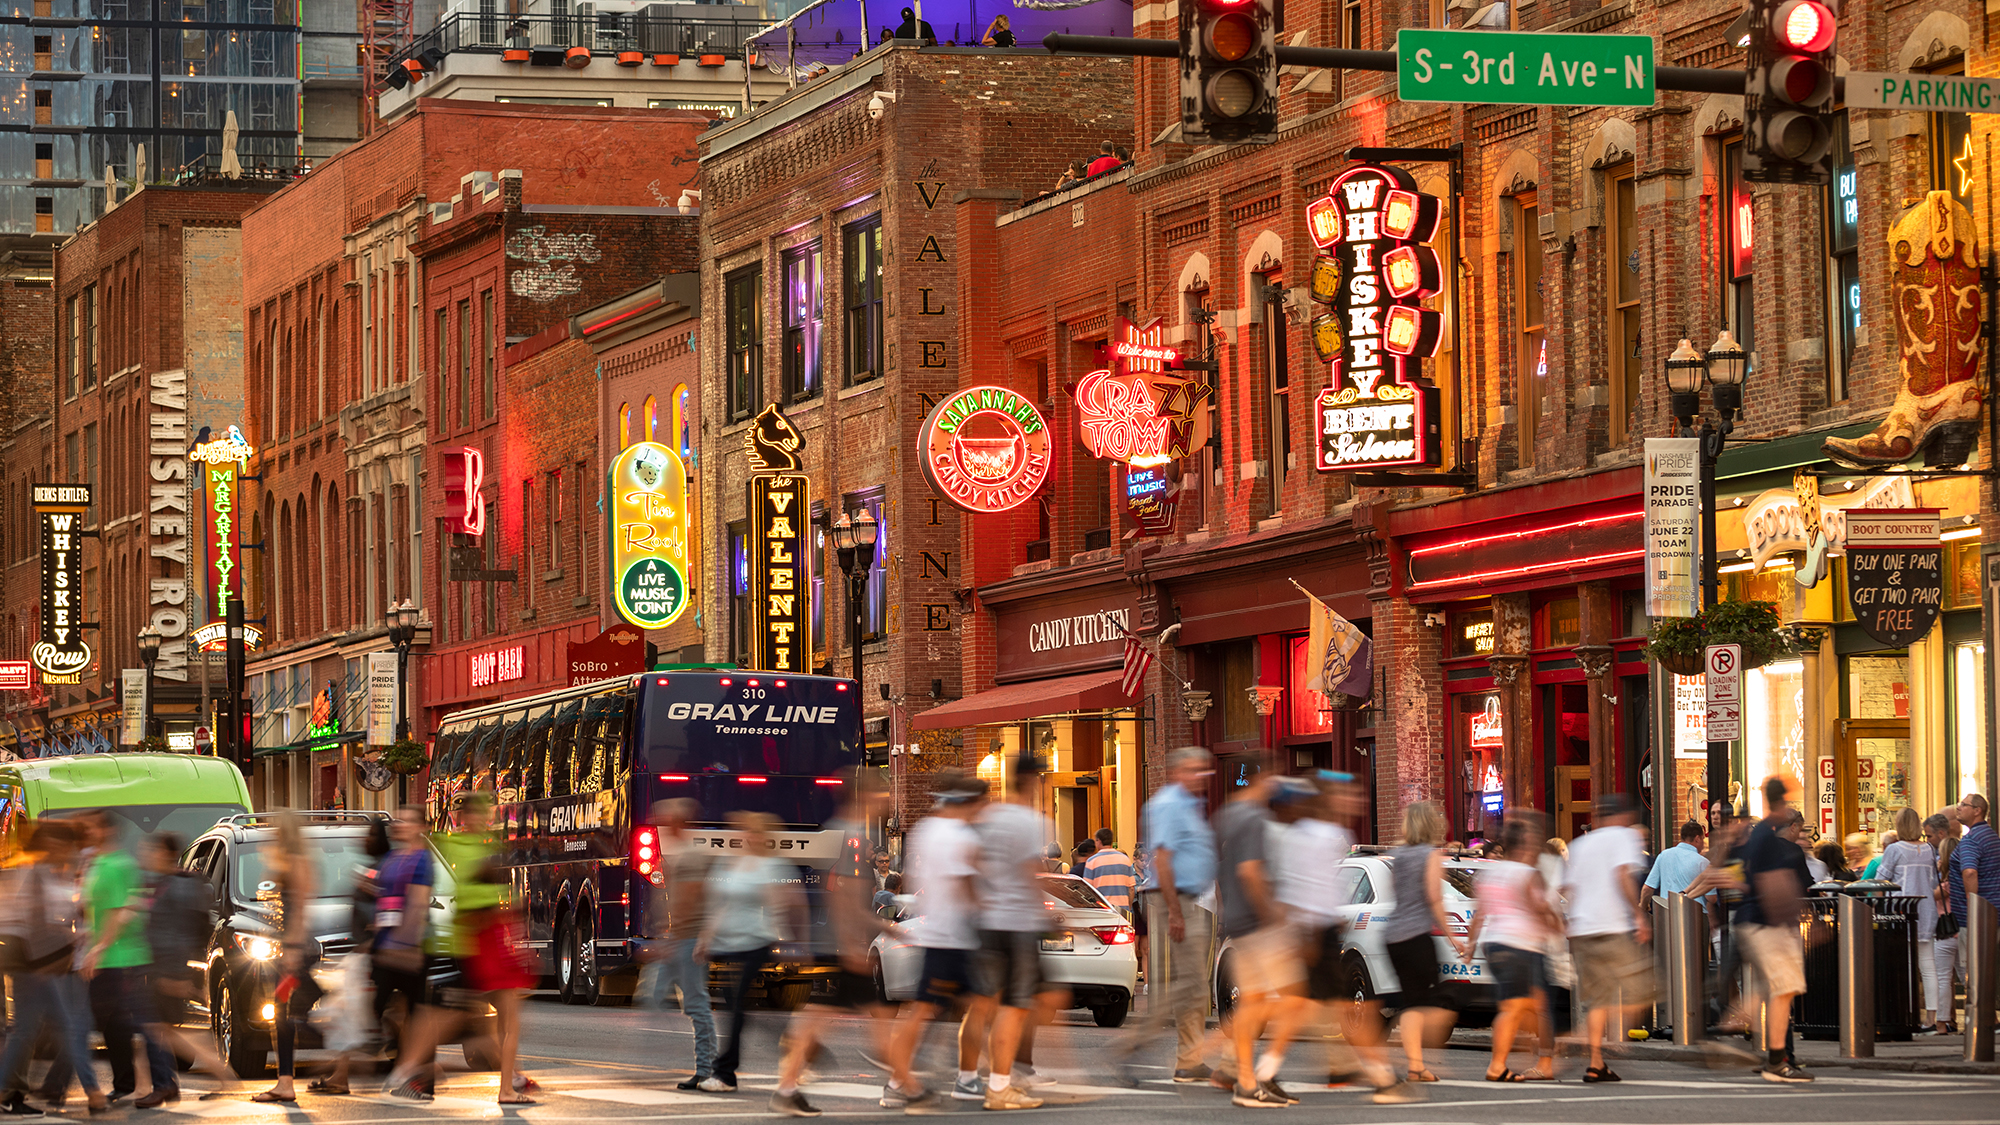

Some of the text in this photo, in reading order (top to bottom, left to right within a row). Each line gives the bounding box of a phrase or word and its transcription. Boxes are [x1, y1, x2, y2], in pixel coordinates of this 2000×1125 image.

[1882, 78, 1991, 109] PARKING
[918, 158, 941, 179] the
[1840, 172, 1856, 197] BU
[1845, 199, 1858, 223] PA
[1341, 179, 1385, 400] WHISKEY
[1117, 342, 1176, 361] Welcome to
[1076, 369, 1213, 419] CRAZY
[914, 181, 951, 632] VALENINE
[938, 388, 1043, 435] SAVANNAH'S
[1322, 403, 1415, 435] BENT
[1081, 417, 1196, 458] TOWN
[1324, 432, 1415, 465] Saloon
[150, 367, 187, 564] WHISKEY
[1659, 459, 1693, 468] PRIDE
[769, 475, 793, 489] the
[935, 452, 1045, 507] CANDY KITCHEN
[1127, 470, 1154, 485] LIVE
[34, 487, 57, 502] DIERKS
[1127, 479, 1166, 496] MUSIC
[1650, 485, 1694, 496] PRIDE
[624, 491, 675, 520] Tin
[1650, 498, 1694, 507] PARADE
[1650, 518, 1694, 526] SATURDAY
[1852, 524, 1935, 535] BOOT COUNTRY
[1649, 526, 1694, 536] JUNE 22
[210, 470, 235, 617] MARGARITAVIL
[620, 522, 683, 559] Roof
[1657, 539, 1687, 548] 10AM
[1650, 551, 1695, 559] BROADWAY
[1854, 553, 1938, 571] BUY ONE PAIR
[646, 559, 657, 572] A
[50, 514, 74, 645] WHISKEY
[638, 573, 666, 586] LIVE
[766, 492, 796, 669] VALENTI
[1887, 570, 1902, 585] &
[630, 587, 675, 601] MUSIC
[1652, 585, 1696, 593] NASHVILLE
[1652, 593, 1696, 602] PRIDE.ORG
[1854, 587, 1941, 605] GET TWO PAIR
[633, 601, 674, 615] JOINT
[1875, 608, 1915, 632] FREE
[150, 578, 188, 682] ROW
[1029, 608, 1130, 653] CANDY KITCHEN
[38, 642, 86, 671] Row
[471, 645, 523, 687] BOOT BARN
[571, 661, 608, 672] SoBro
[43, 672, 81, 685] NASHVILLE
[1708, 676, 1737, 685] LOADING
[742, 687, 766, 700] 310
[1677, 687, 1705, 700] Buy ON
[1714, 684, 1732, 692] ZONE
[667, 701, 839, 724] GRAY LINE
[1677, 700, 1706, 711] Get TW
[1686, 714, 1706, 728] FRE
[715, 724, 789, 736] Tennessee
[550, 801, 603, 834] GRAY LINE
[564, 838, 588, 852] Tennessee
